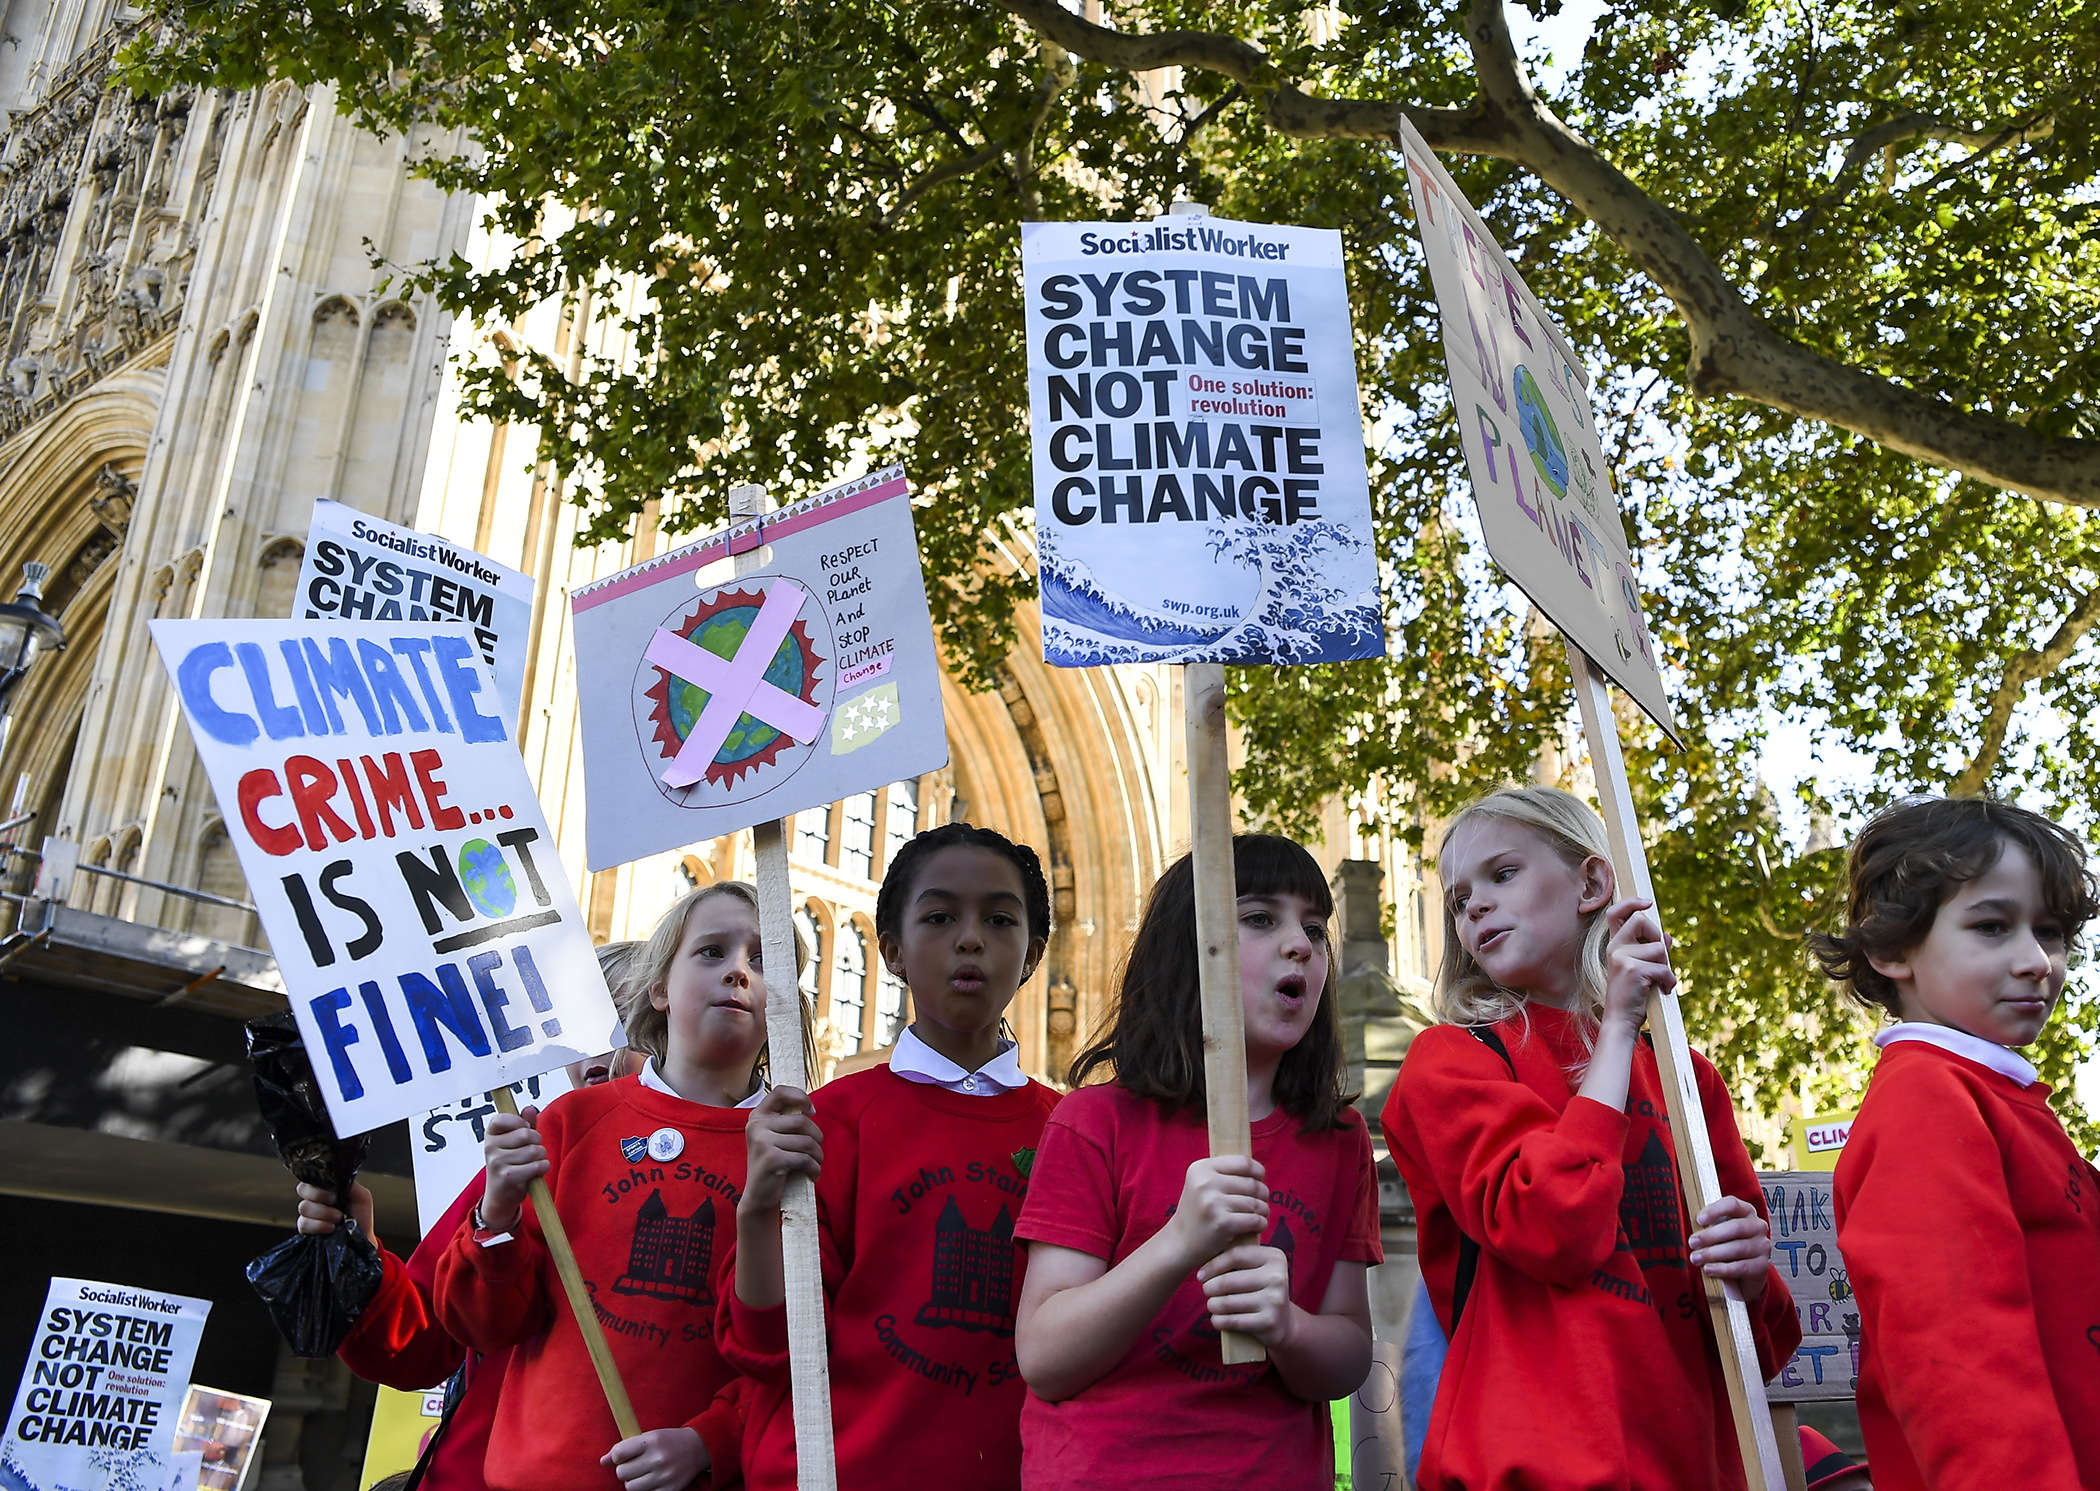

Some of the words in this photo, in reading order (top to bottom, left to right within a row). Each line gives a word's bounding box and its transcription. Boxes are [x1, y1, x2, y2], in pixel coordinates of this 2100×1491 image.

[1040, 269, 1291, 323] SYSTEM
[1044, 320, 1309, 373] CHANGE
[1047, 370, 1178, 421] NOT
[1188, 374, 1226, 394] One
[1232, 379, 1314, 400] solution:
[1191, 397, 1287, 419] revolution
[1049, 421, 1324, 475] CLIMATE
[1052, 474, 1322, 526] CHANGE
[313, 540, 494, 628] SYSTEM
[1162, 597, 1240, 619] swp.org.uk
[839, 638, 894, 670] CLIMATE
[843, 662, 883, 683] Change
[177, 635, 507, 749] CLIMATE
[237, 748, 514, 857] CRIME...
[281, 859, 384, 967] IS
[395, 826, 553, 936] NOT
[309, 944, 563, 1103] FINE!
[1809, 1127, 1851, 1146] CLIM
[602, 1167, 665, 1204] John
[891, 1165, 955, 1215] John
[1269, 1189, 1323, 1236] ainer
[1763, 1185, 1831, 1237] MAK
[1775, 1240, 1827, 1278] TO
[47, 1307, 174, 1347] SYSTEM
[40, 1334, 173, 1374] CHANGE
[874, 1313, 978, 1397] Community
[32, 1361, 105, 1390] NOT
[105, 1383, 149, 1396] revolution
[108, 1370, 125, 1382] One
[127, 1375, 166, 1389] solution:
[26, 1388, 162, 1426] CLIMATE
[17, 1415, 153, 1450] CHANGE
